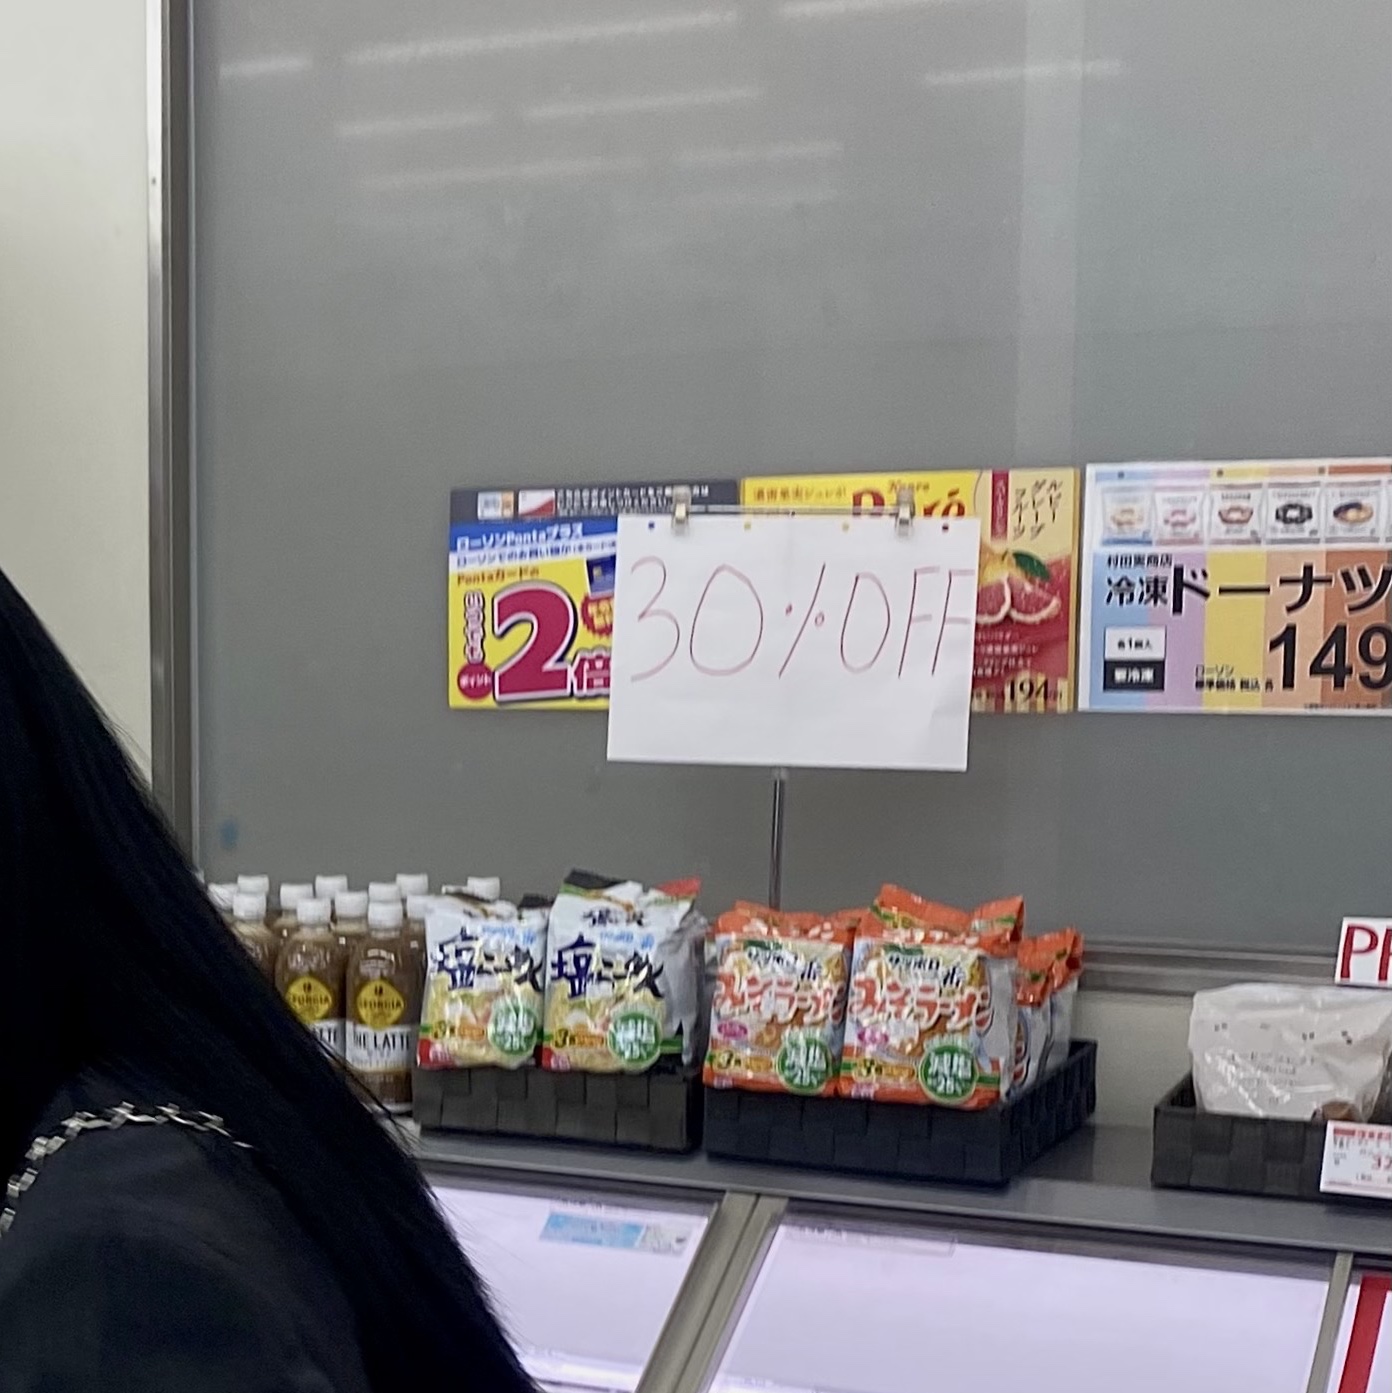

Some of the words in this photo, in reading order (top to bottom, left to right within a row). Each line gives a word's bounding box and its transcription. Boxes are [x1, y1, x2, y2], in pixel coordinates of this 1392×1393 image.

[629, 555, 975, 681] 30%OFF
[1105, 563, 1392, 616] 冷凍ドーナツ
[1269, 622, 1392, 692] 149
